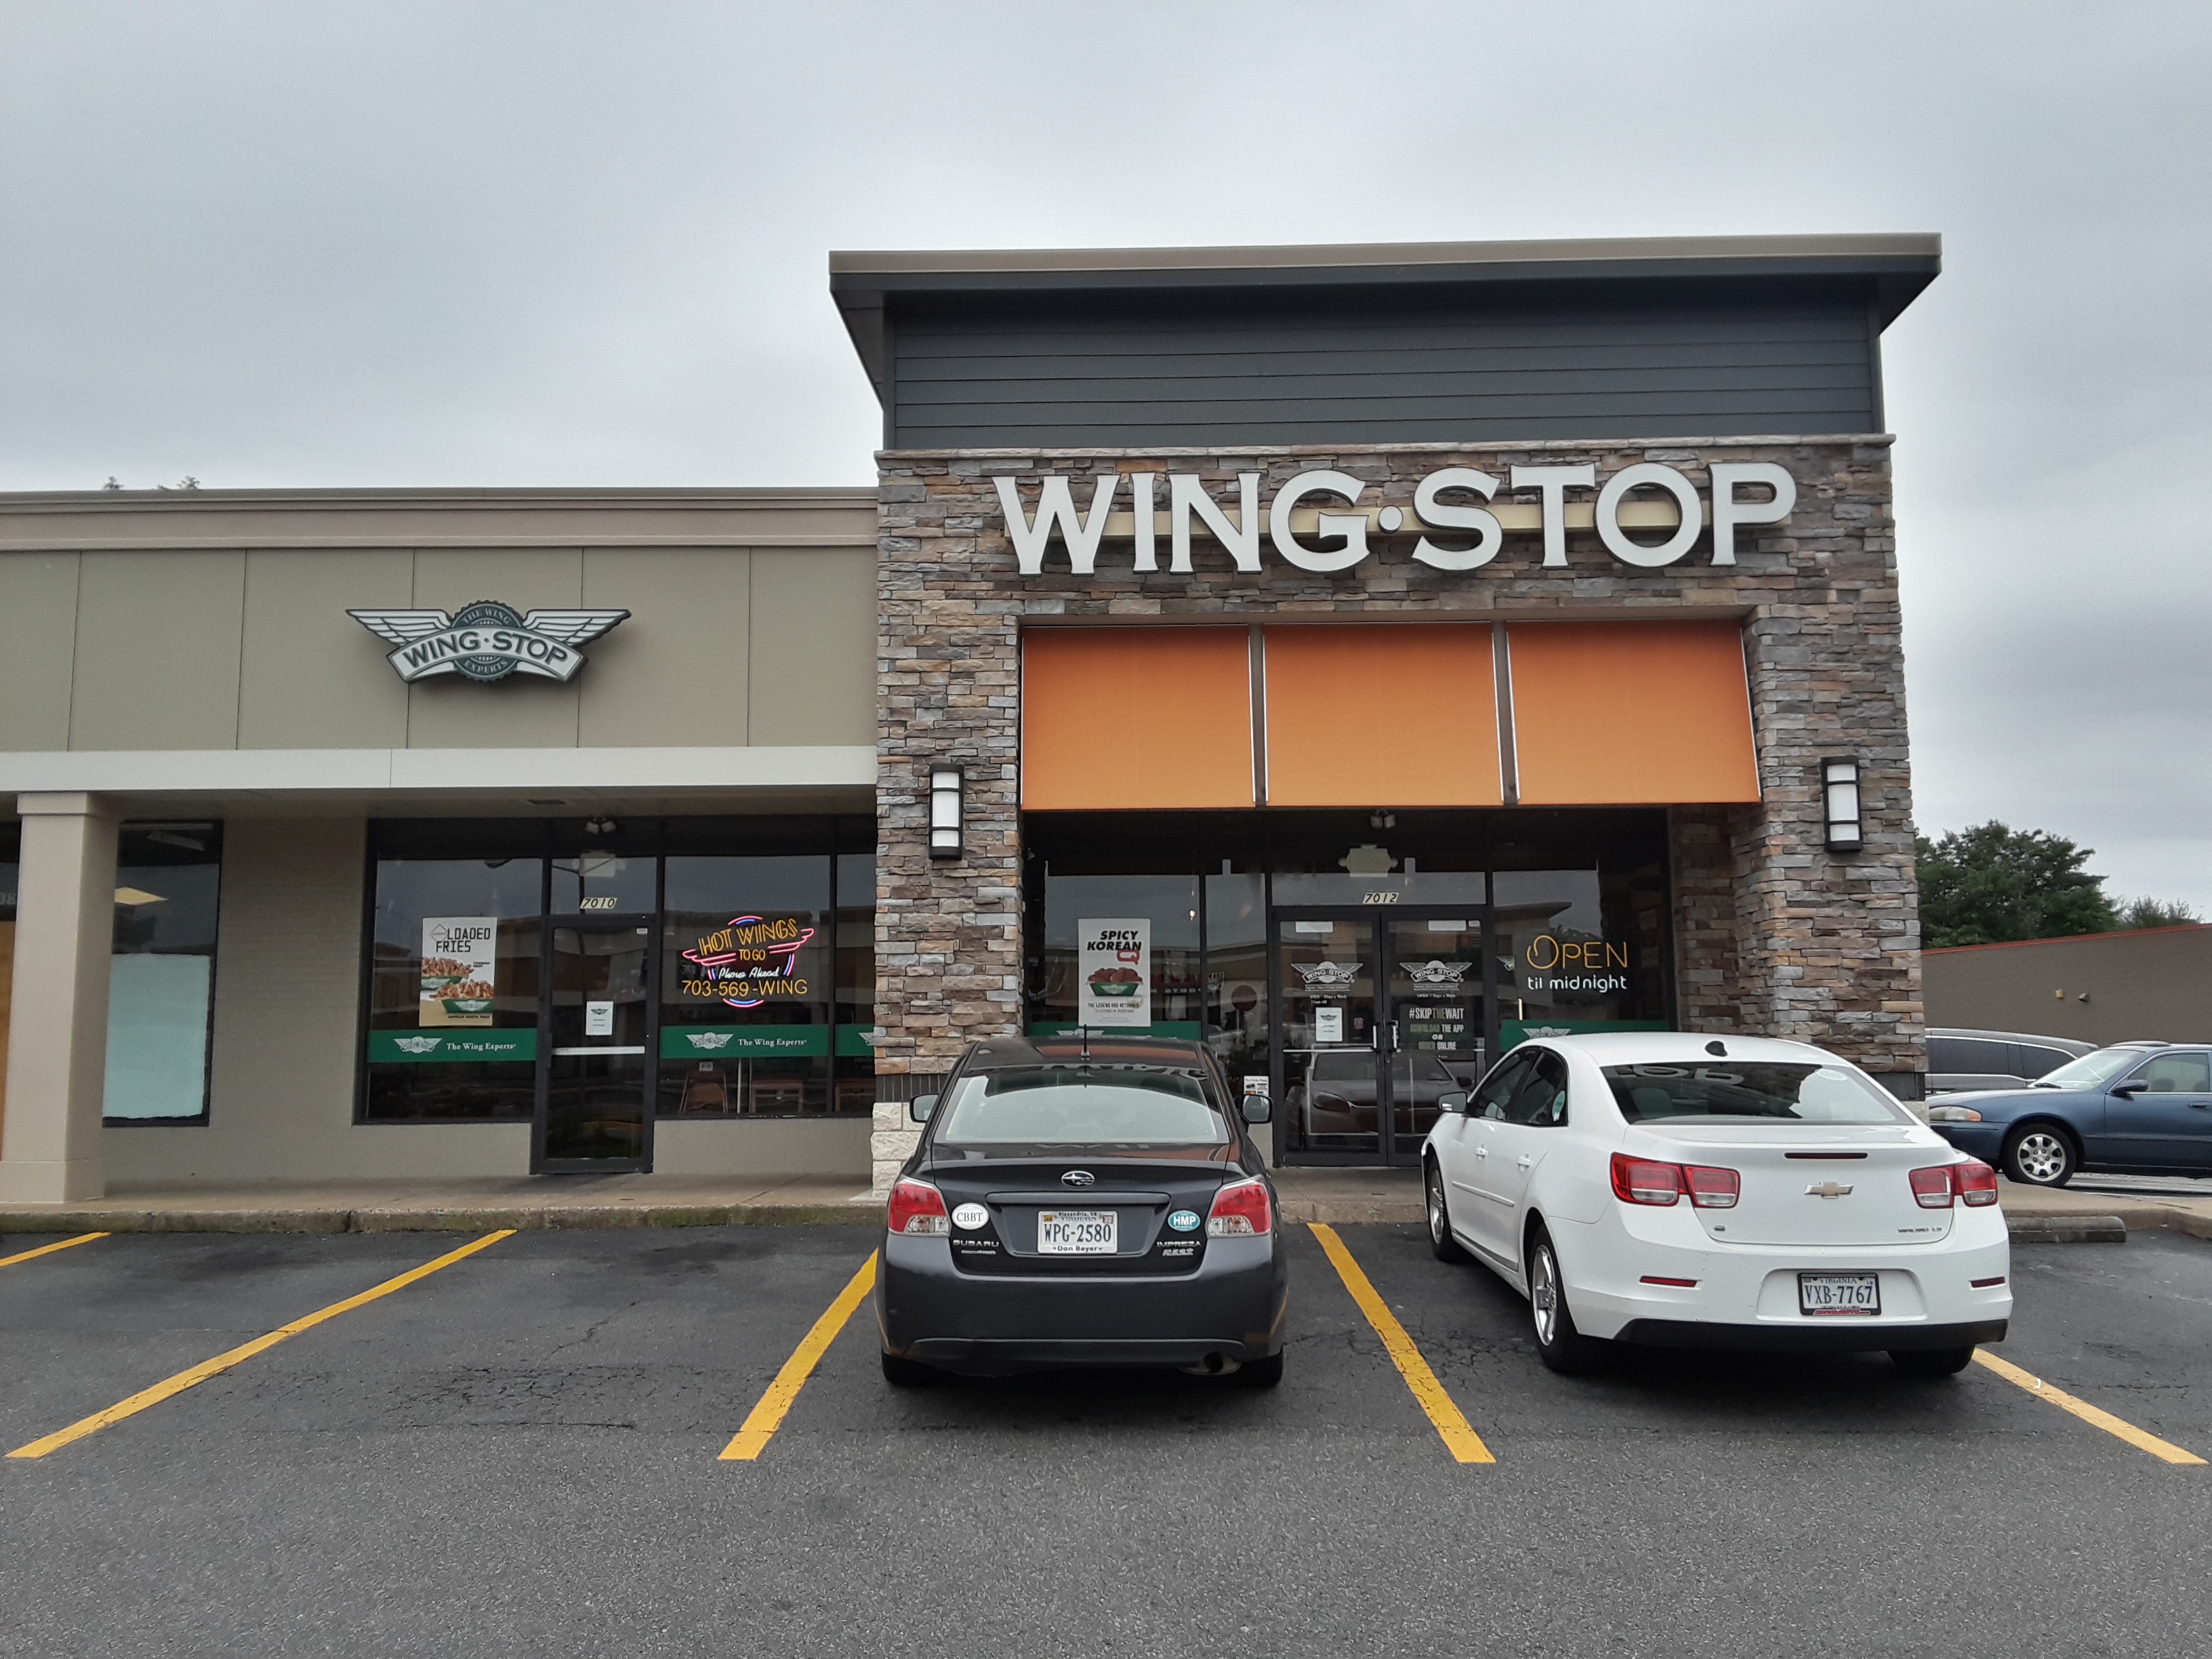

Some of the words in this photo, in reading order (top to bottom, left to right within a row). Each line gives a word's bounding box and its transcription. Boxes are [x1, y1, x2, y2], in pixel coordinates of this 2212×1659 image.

[583, 898, 615, 908] 7010
[1365, 893, 1397, 903] 7012
[447, 927, 491, 940] LOADED
[698, 928, 733, 956] HOT
[736, 918, 798, 946] WINGS
[1100, 930, 1139, 940] SPICY
[436, 940, 472, 953] FRIES
[1087, 941, 1142, 950] KOREAN
[739, 949, 750, 961] TO
[752, 949, 766, 961] GO
[1526, 935, 1628, 970] OPEN
[748, 966, 780, 978] Ahead
[1528, 976, 1542, 990] til
[1550, 974, 1627, 993] midnight
[446, 1042, 461, 1050] The
[462, 1042, 483, 1052] Wing
[754, 1038, 775, 1048] Wing
[956, 1212, 983, 1222] CBBT
[1173, 1215, 1196, 1225] HMP
[1044, 1223, 1111, 1242] WPG-2580
[953, 1240, 1000, 1248] SUBARU
